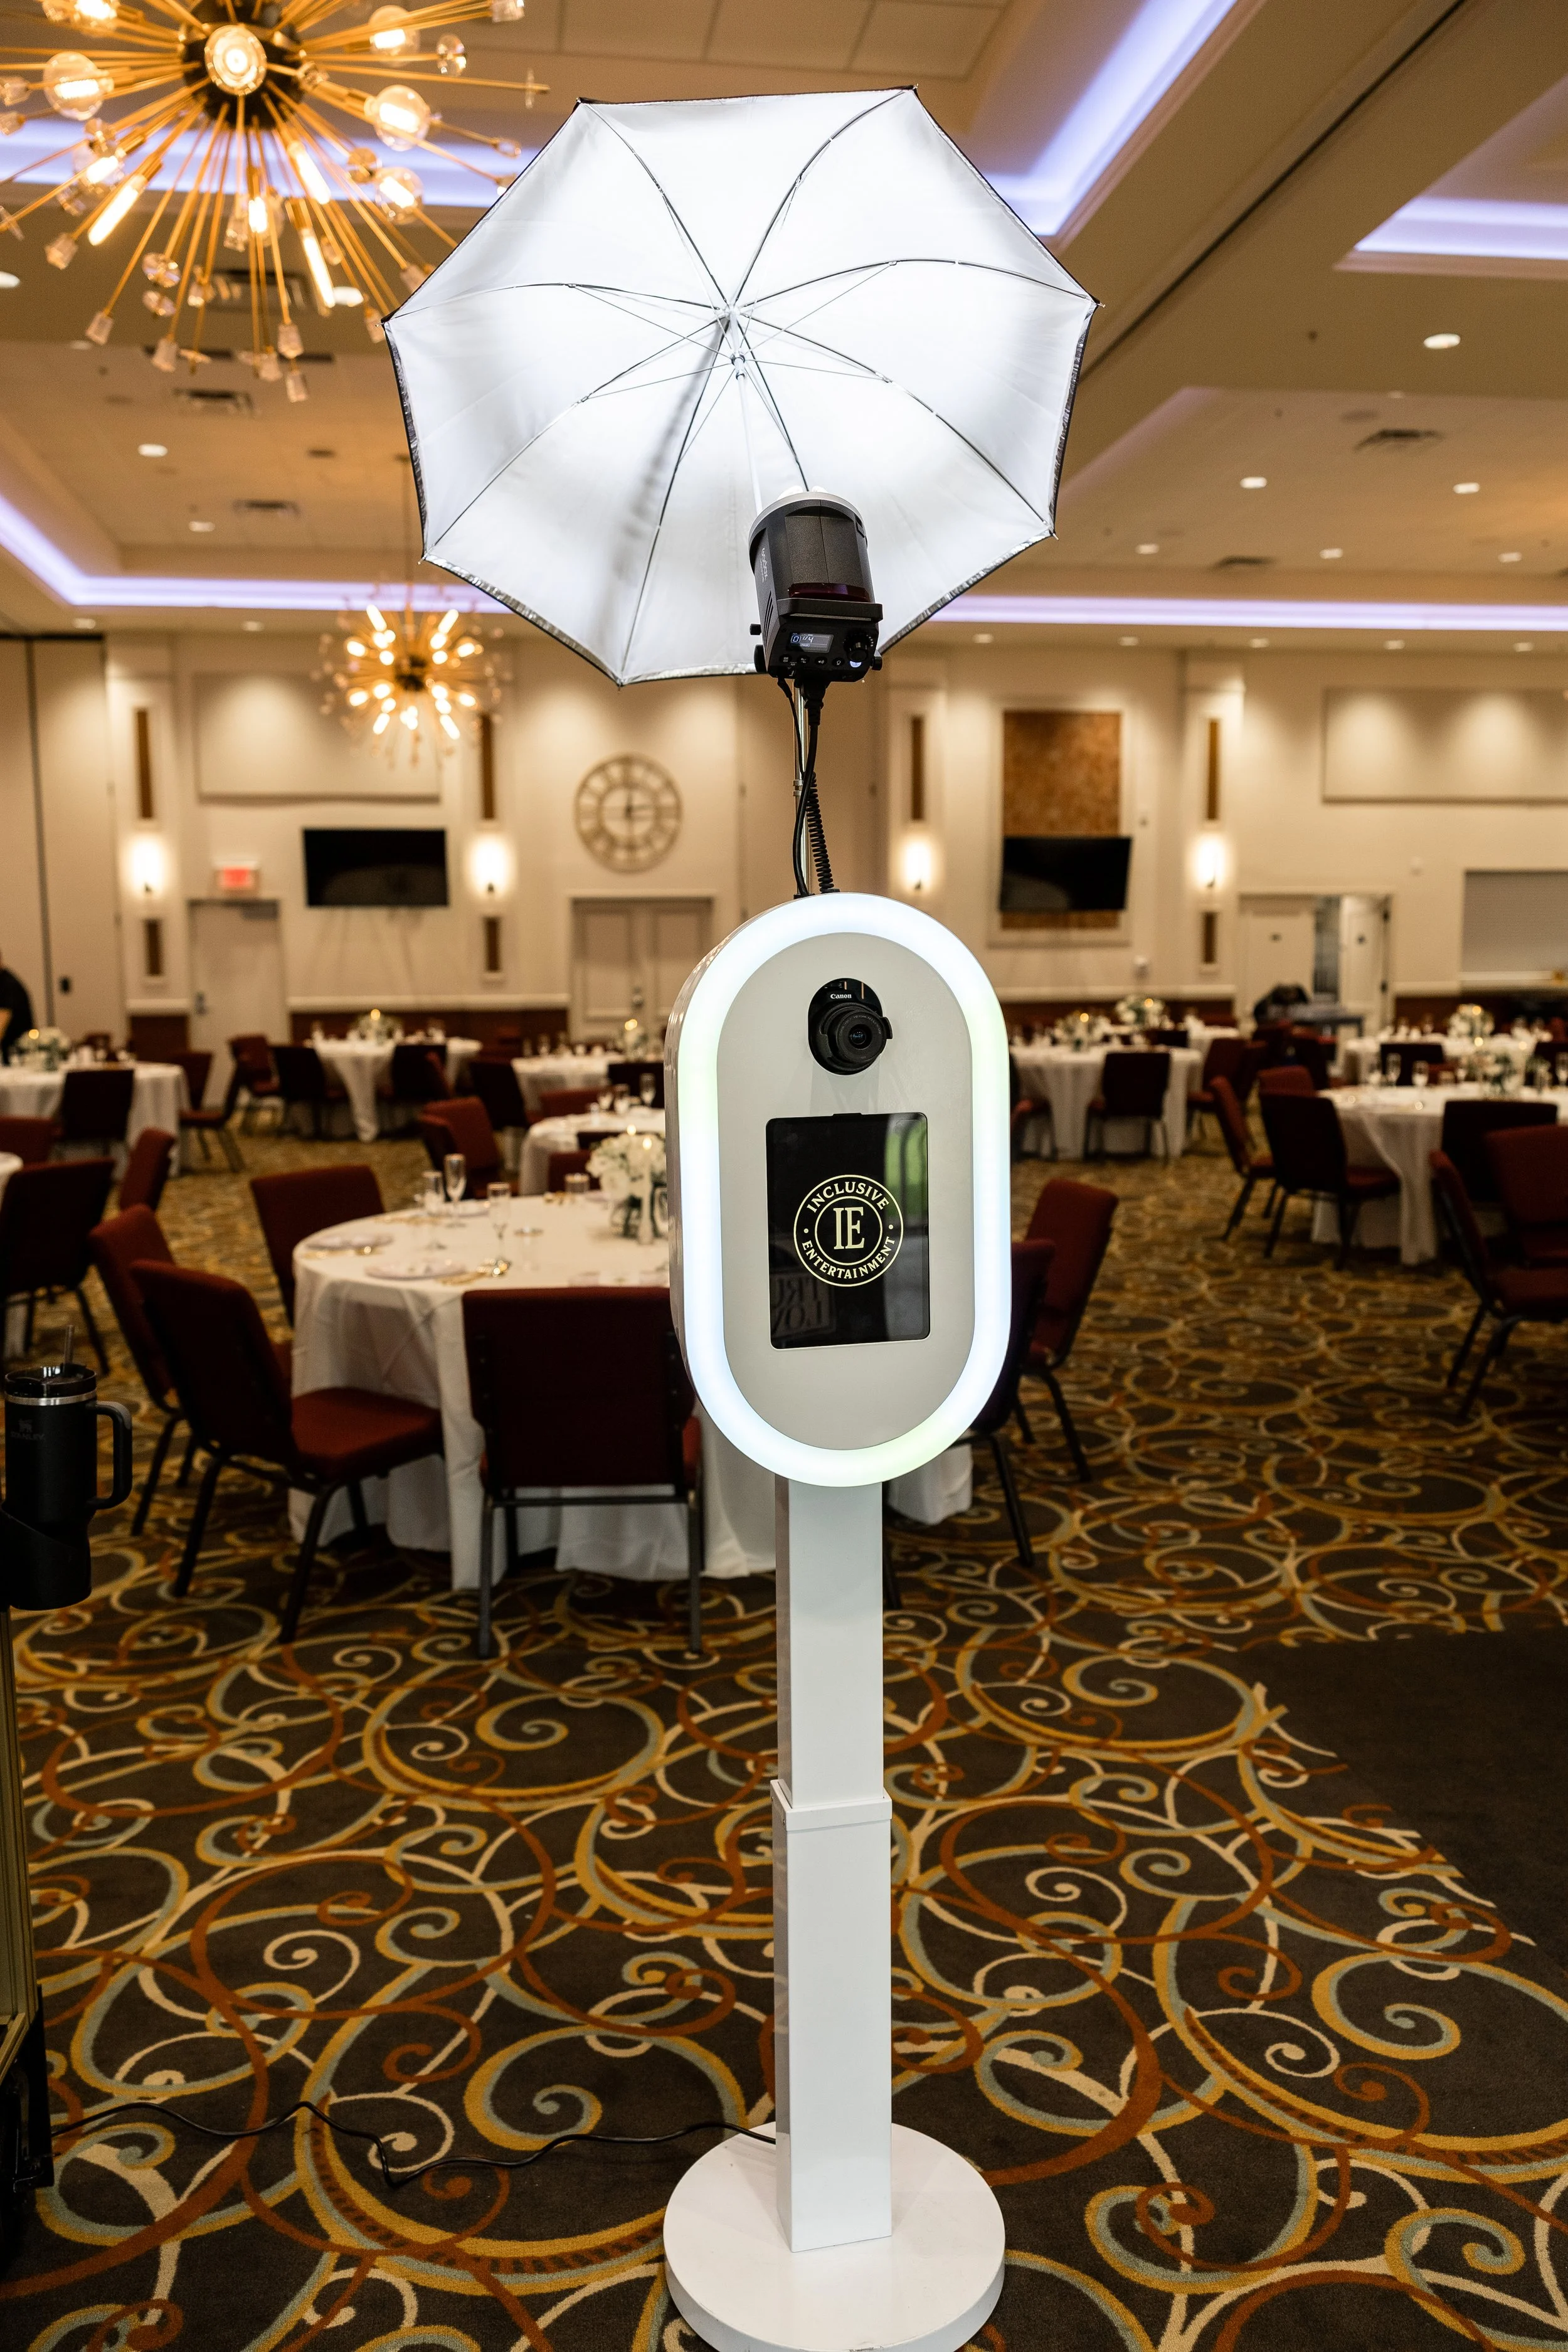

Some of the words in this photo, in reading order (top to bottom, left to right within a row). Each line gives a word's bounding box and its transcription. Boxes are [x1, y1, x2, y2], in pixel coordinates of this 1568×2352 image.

[807, 1182, 889, 1213] INCLUSIVE
[834, 1207, 865, 1250] IE
[802, 1236, 896, 1279] ENTERTAINMENT
